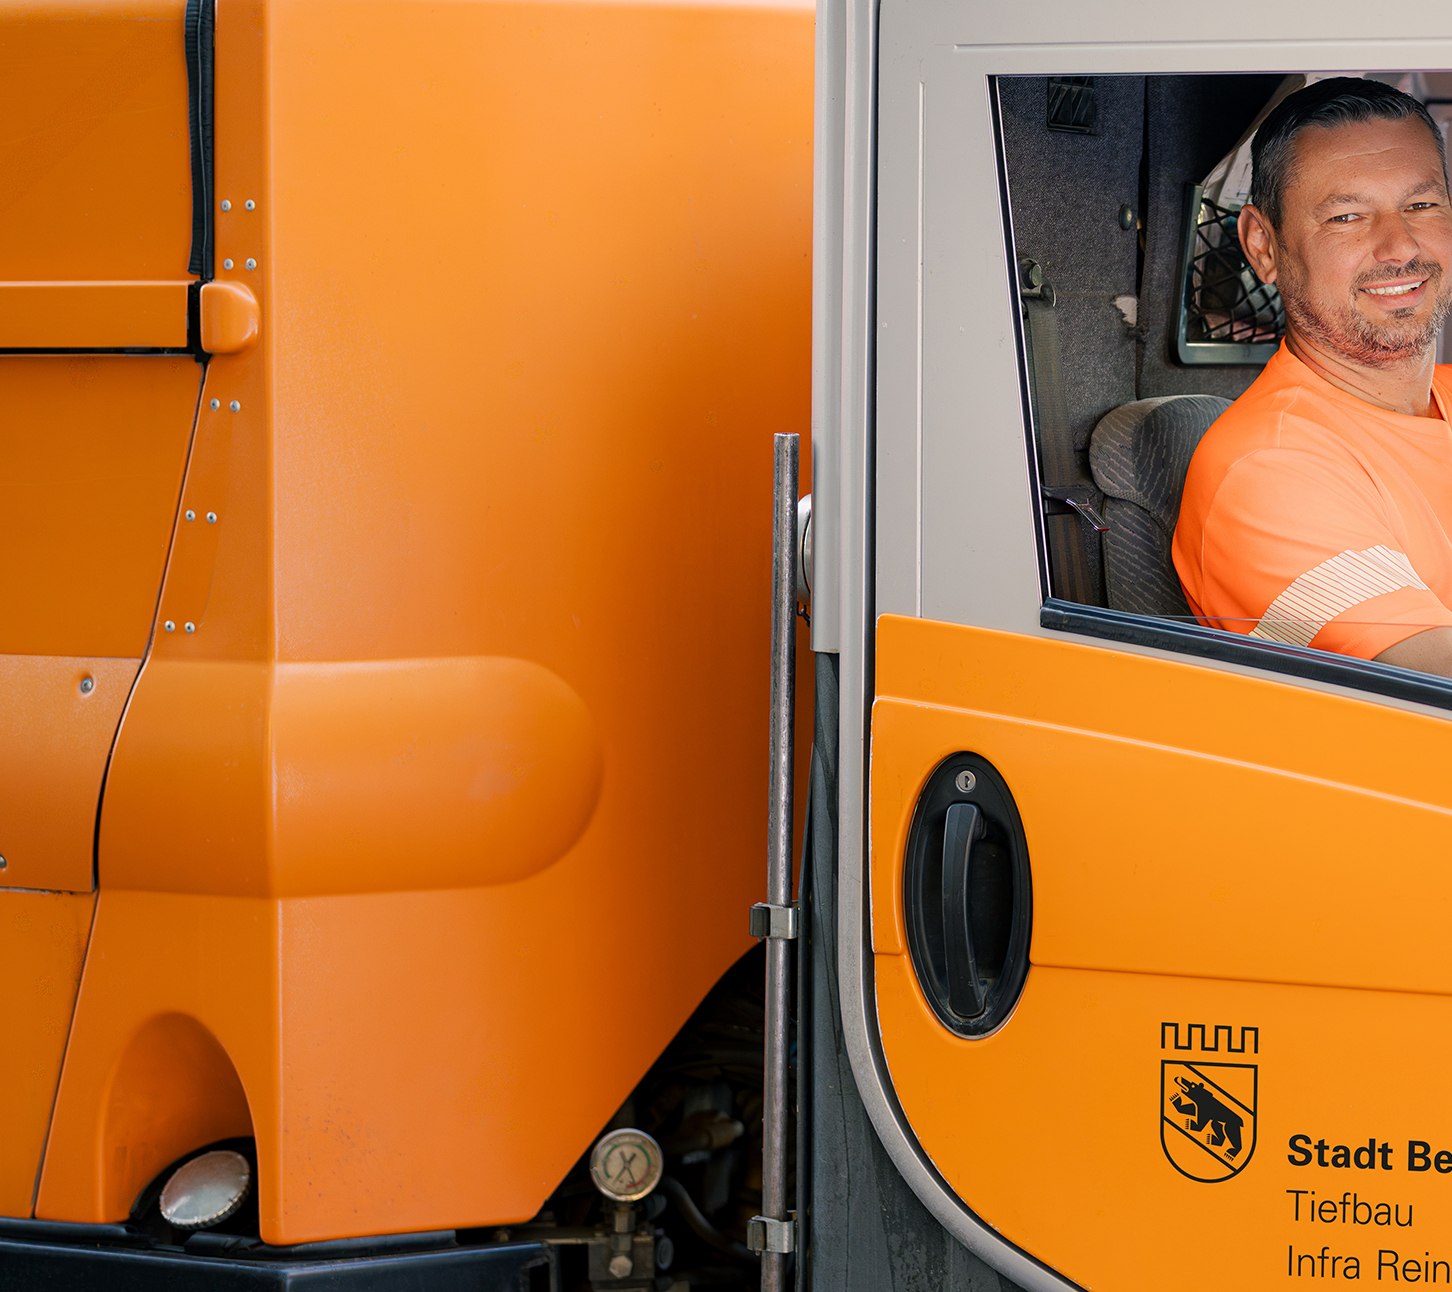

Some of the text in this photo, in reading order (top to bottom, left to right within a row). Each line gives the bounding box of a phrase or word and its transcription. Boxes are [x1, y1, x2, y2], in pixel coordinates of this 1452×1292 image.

[1287, 1133, 1394, 1171] Stadt
[1285, 1189, 1413, 1227] Tiefbau
[1288, 1244, 1360, 1280] Infra
